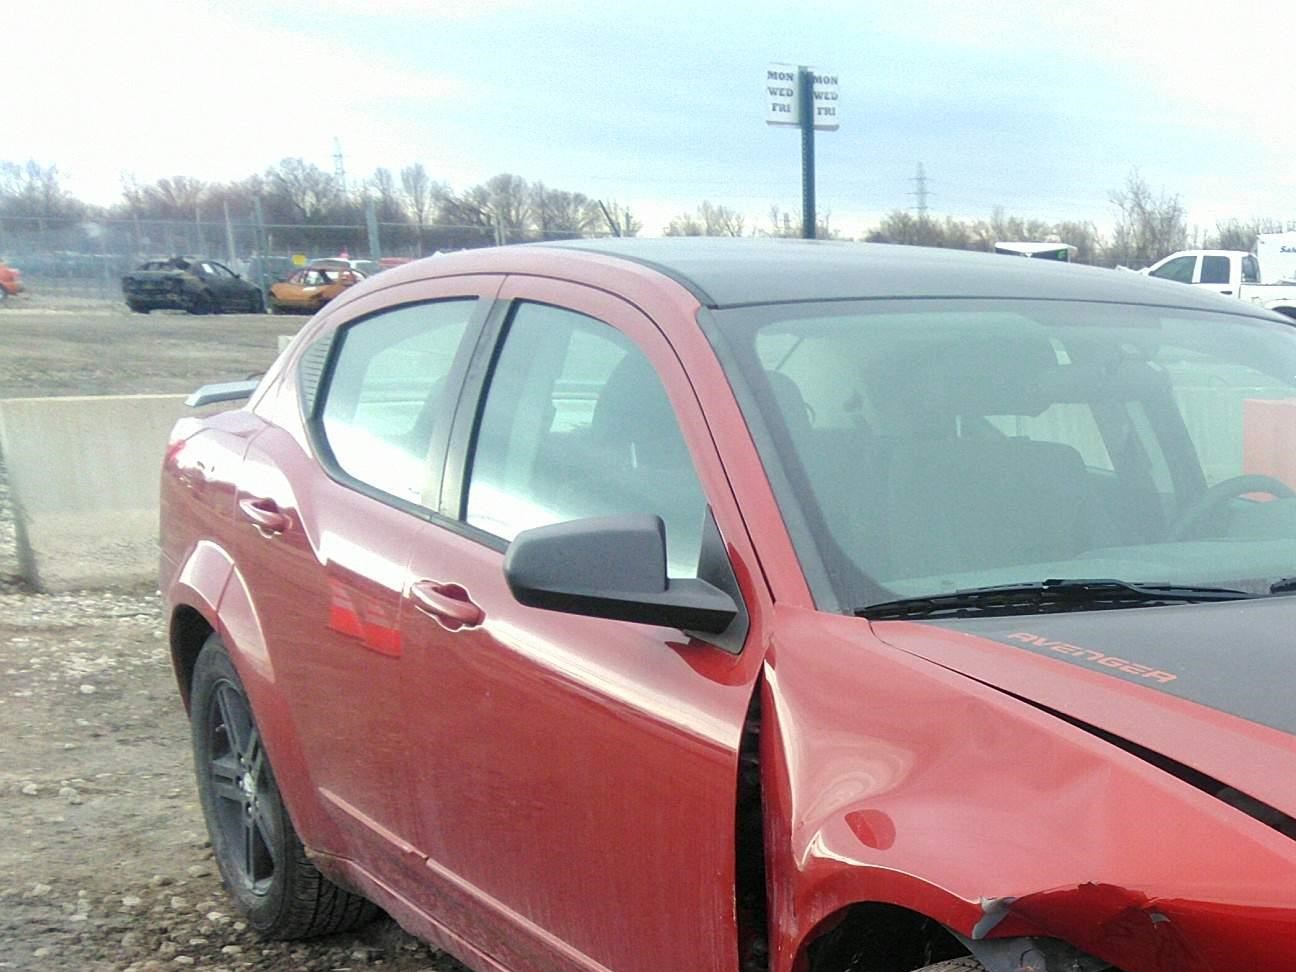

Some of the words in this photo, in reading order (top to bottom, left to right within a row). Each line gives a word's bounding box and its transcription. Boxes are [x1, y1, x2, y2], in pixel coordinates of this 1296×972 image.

[767, 70, 794, 81] MON
[813, 75, 838, 85] MON
[767, 86, 794, 97] WED
[813, 91, 839, 101] WED
[771, 102, 791, 113] FRI
[816, 106, 836, 116] FRI
[1007, 632, 1177, 683] AVENGER
